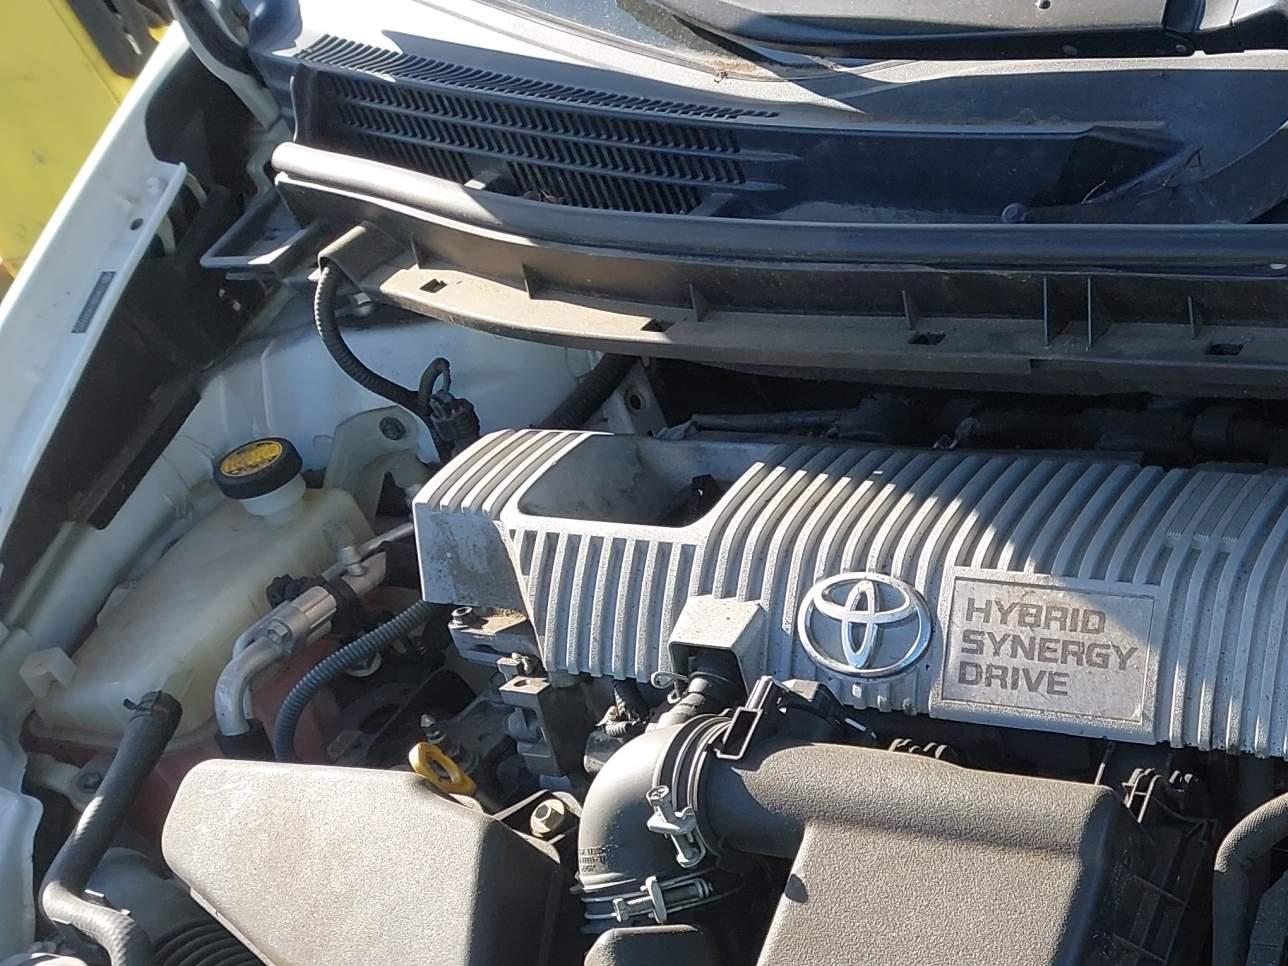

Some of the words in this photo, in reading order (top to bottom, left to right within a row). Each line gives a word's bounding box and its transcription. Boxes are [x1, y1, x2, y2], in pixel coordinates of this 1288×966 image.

[965, 597, 1106, 635] HYBRID
[960, 629, 1138, 671] SYNERGY
[957, 660, 1070, 697] DRIVE
